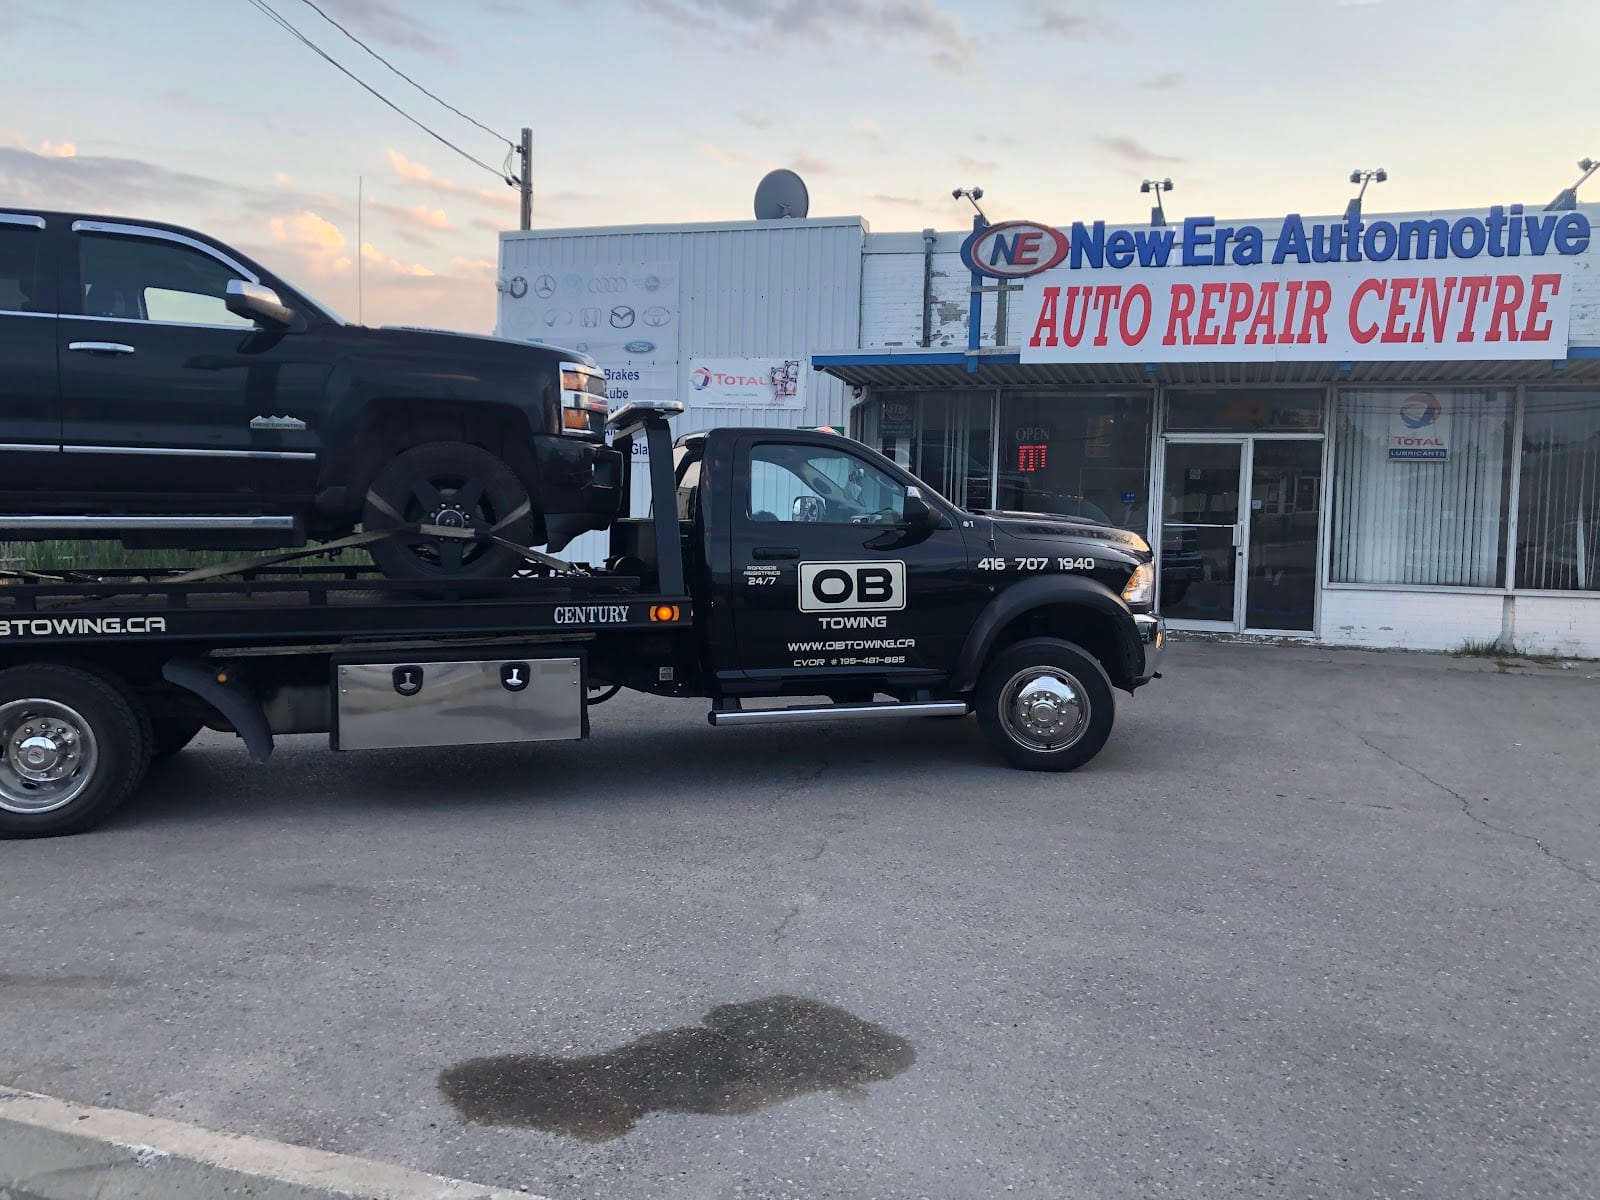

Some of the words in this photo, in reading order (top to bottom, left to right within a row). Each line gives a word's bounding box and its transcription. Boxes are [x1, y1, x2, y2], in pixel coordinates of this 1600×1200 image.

[1070, 220, 1176, 270] New
[1183, 216, 1264, 266] Era
[1271, 203, 1591, 265] Automotive
[990, 232, 1043, 265] NE
[1029, 283, 1152, 347] AUTO
[1162, 280, 1330, 346] REPAIR
[1348, 274, 1561, 344] CENTRE
[604, 368, 640, 381] Brakes
[714, 373, 769, 386] TOTAL
[1015, 427, 1050, 441] OPEN
[1394, 436, 1444, 446] TOTAL
[631, 443, 648, 455] Gla
[978, 558, 1006, 570] 416
[1015, 558, 1049, 570] 707
[1057, 558, 1095, 570] 1940
[748, 577, 777, 585] 24/7
[812, 568, 893, 604] OB
[554, 605, 630, 624] CENTURY
[818, 616, 887, 630] TOWING
[787, 638, 916, 652] WWW.OBTOWING.CA
[793, 658, 826, 667] CVOR
